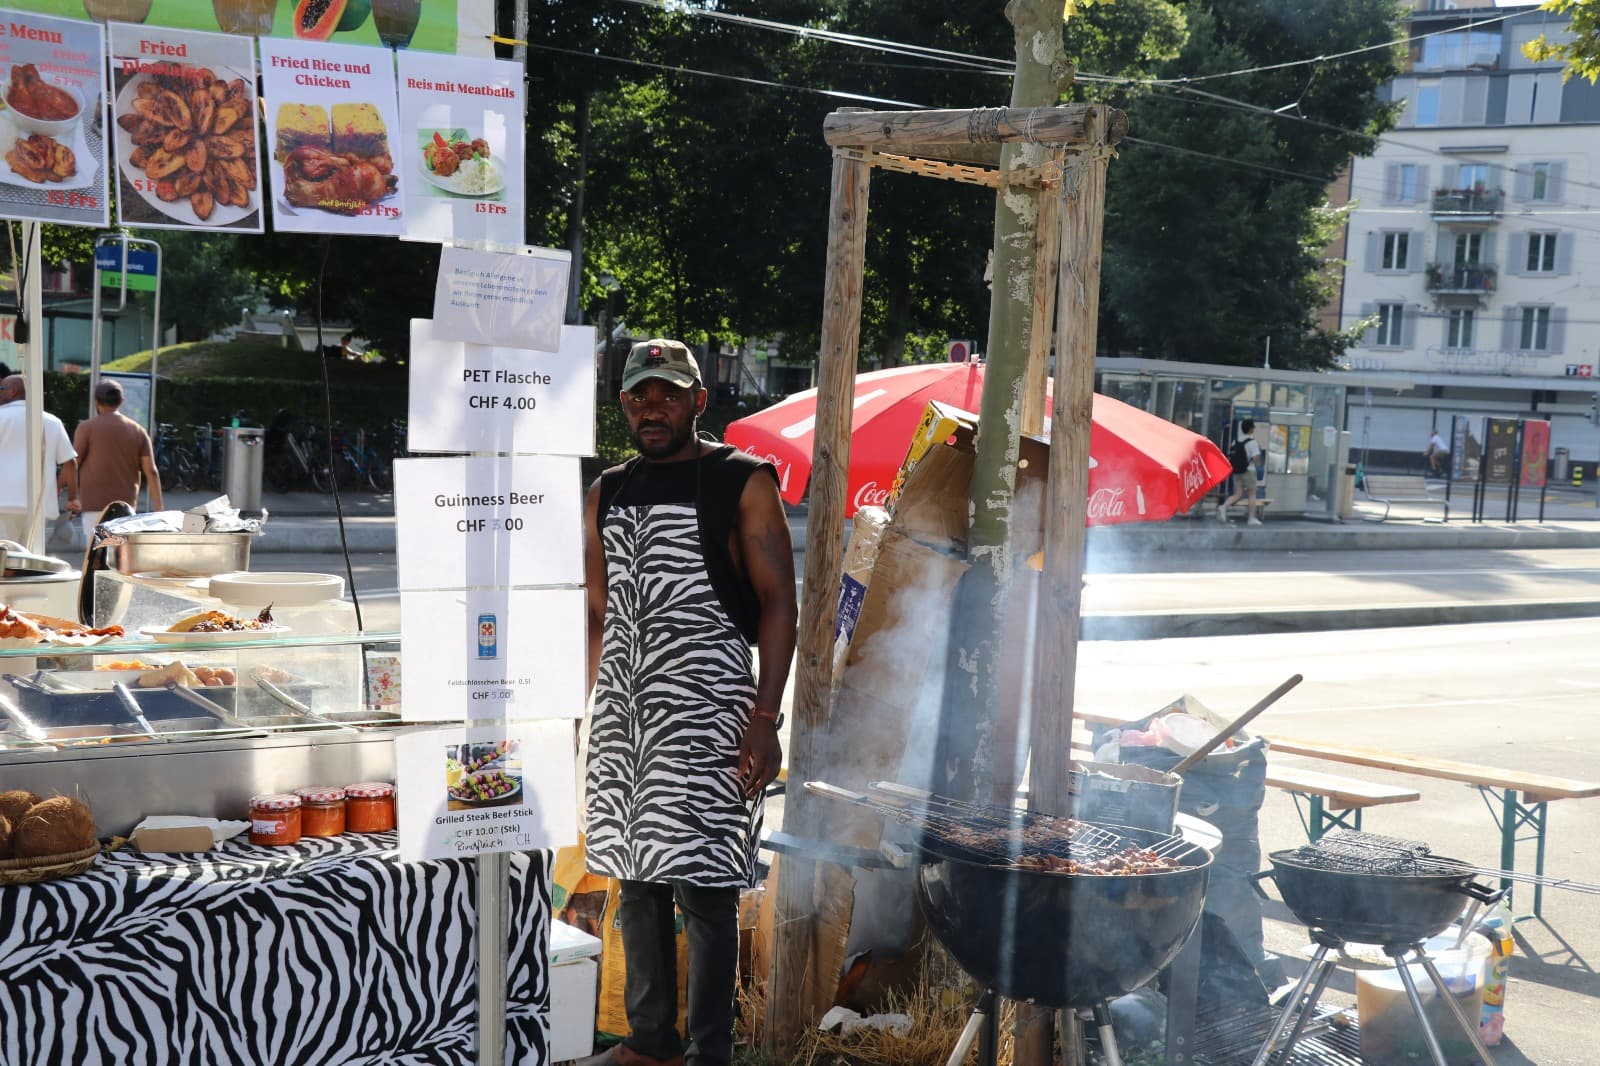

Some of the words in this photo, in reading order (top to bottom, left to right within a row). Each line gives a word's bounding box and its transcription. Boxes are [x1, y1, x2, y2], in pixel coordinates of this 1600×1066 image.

[9, 22, 63, 44] Menu
[140, 39, 187, 57] Fried
[271, 55, 310, 70] Fried
[311, 58, 342, 72] Rice
[344, 61, 371, 75] und
[295, 73, 351, 89] Chicken
[407, 77, 433, 91] Reis
[435, 81, 455, 92] mit
[457, 82, 515, 99] Meatballs
[134, 179, 143, 191] 5
[68, 191, 97, 208] Frs
[375, 202, 399, 217] Frs
[475, 202, 486, 214] 13
[488, 203, 507, 215] Frs
[463, 369, 491, 383] PET
[495, 370, 551, 384] Flasche
[469, 395, 499, 409] CHF
[503, 396, 536, 410] 4.00
[434, 494, 505, 508] Guinness
[509, 492, 544, 505] Beer
[456, 519, 486, 533] CHF
[472, 691, 490, 700] CHF
[491, 691, 511, 700] 5.00
[435, 813, 465, 825] Grilled
[466, 811, 491, 823] Steak
[492, 809, 511, 820] Beef
[513, 807, 534, 818] Stick
[476, 825, 498, 836] 10.0
[500, 823, 521, 835] (Stk)
